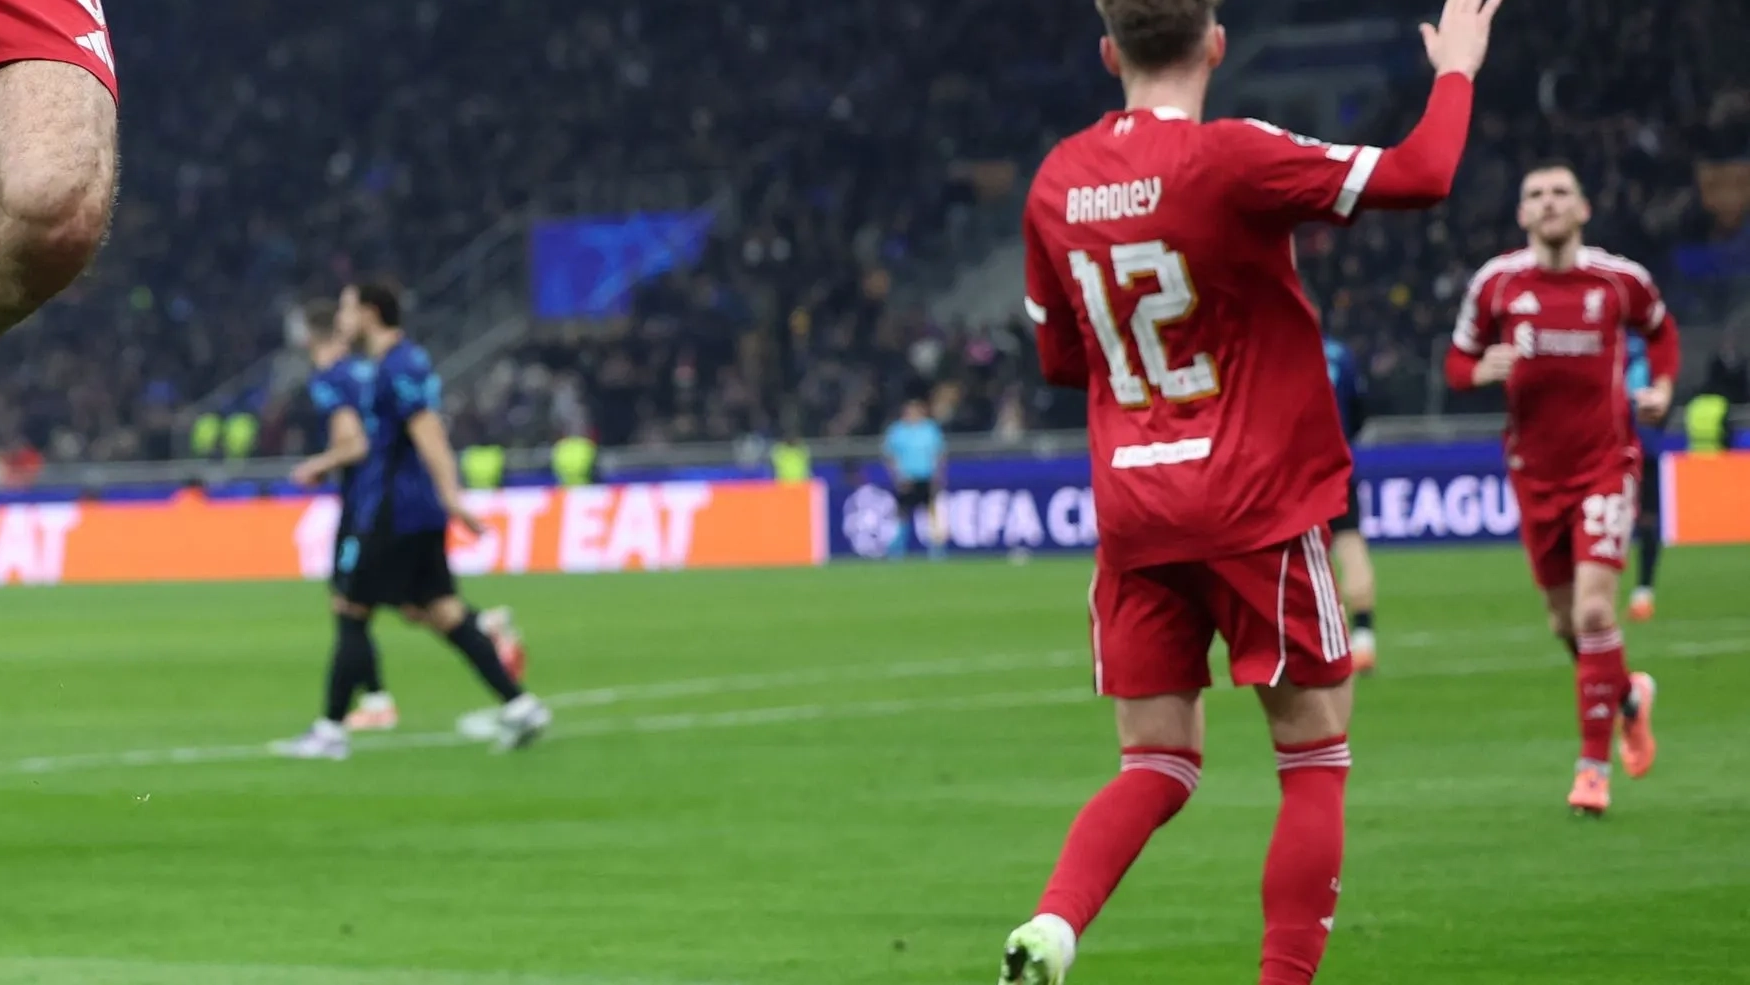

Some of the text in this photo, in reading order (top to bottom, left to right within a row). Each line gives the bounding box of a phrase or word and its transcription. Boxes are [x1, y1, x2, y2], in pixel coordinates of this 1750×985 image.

[1066, 176, 1161, 224] BRADLEY
[1068, 239, 1221, 409] 12
[556, 481, 714, 572] EAT
[1356, 473, 1521, 539] LEAGU
